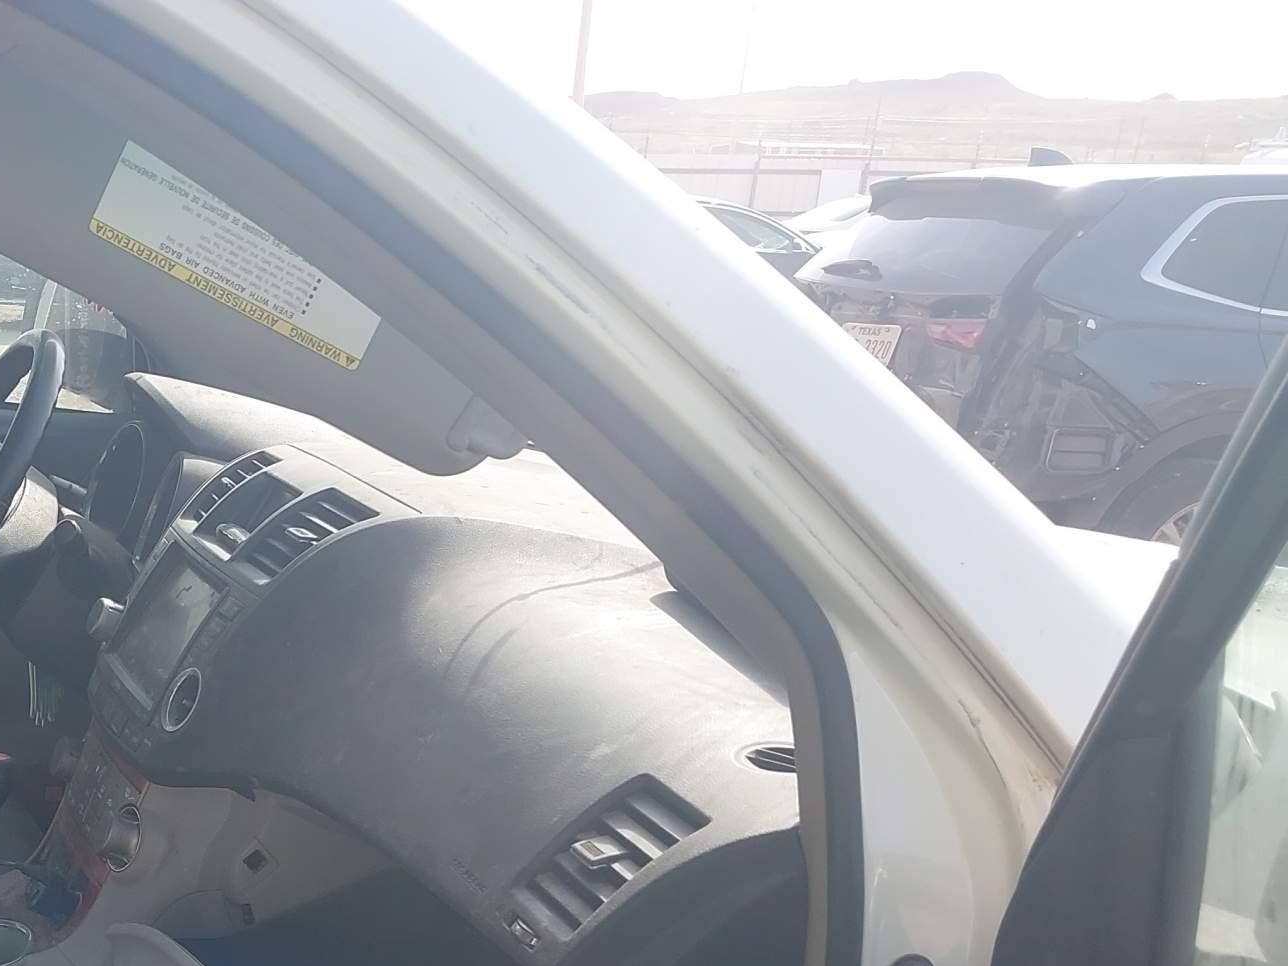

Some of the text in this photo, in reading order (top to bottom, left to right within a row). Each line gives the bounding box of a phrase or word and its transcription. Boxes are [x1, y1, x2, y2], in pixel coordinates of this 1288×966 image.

[92, 222, 176, 273] ADVERTENCIA
[157, 241, 295, 320] EVEN WITH ADVANCED AIR BAGS
[185, 271, 279, 327] AVERTISSEMENT
[287, 325, 343, 362] WARNING
[857, 327, 881, 337] TEXAS
